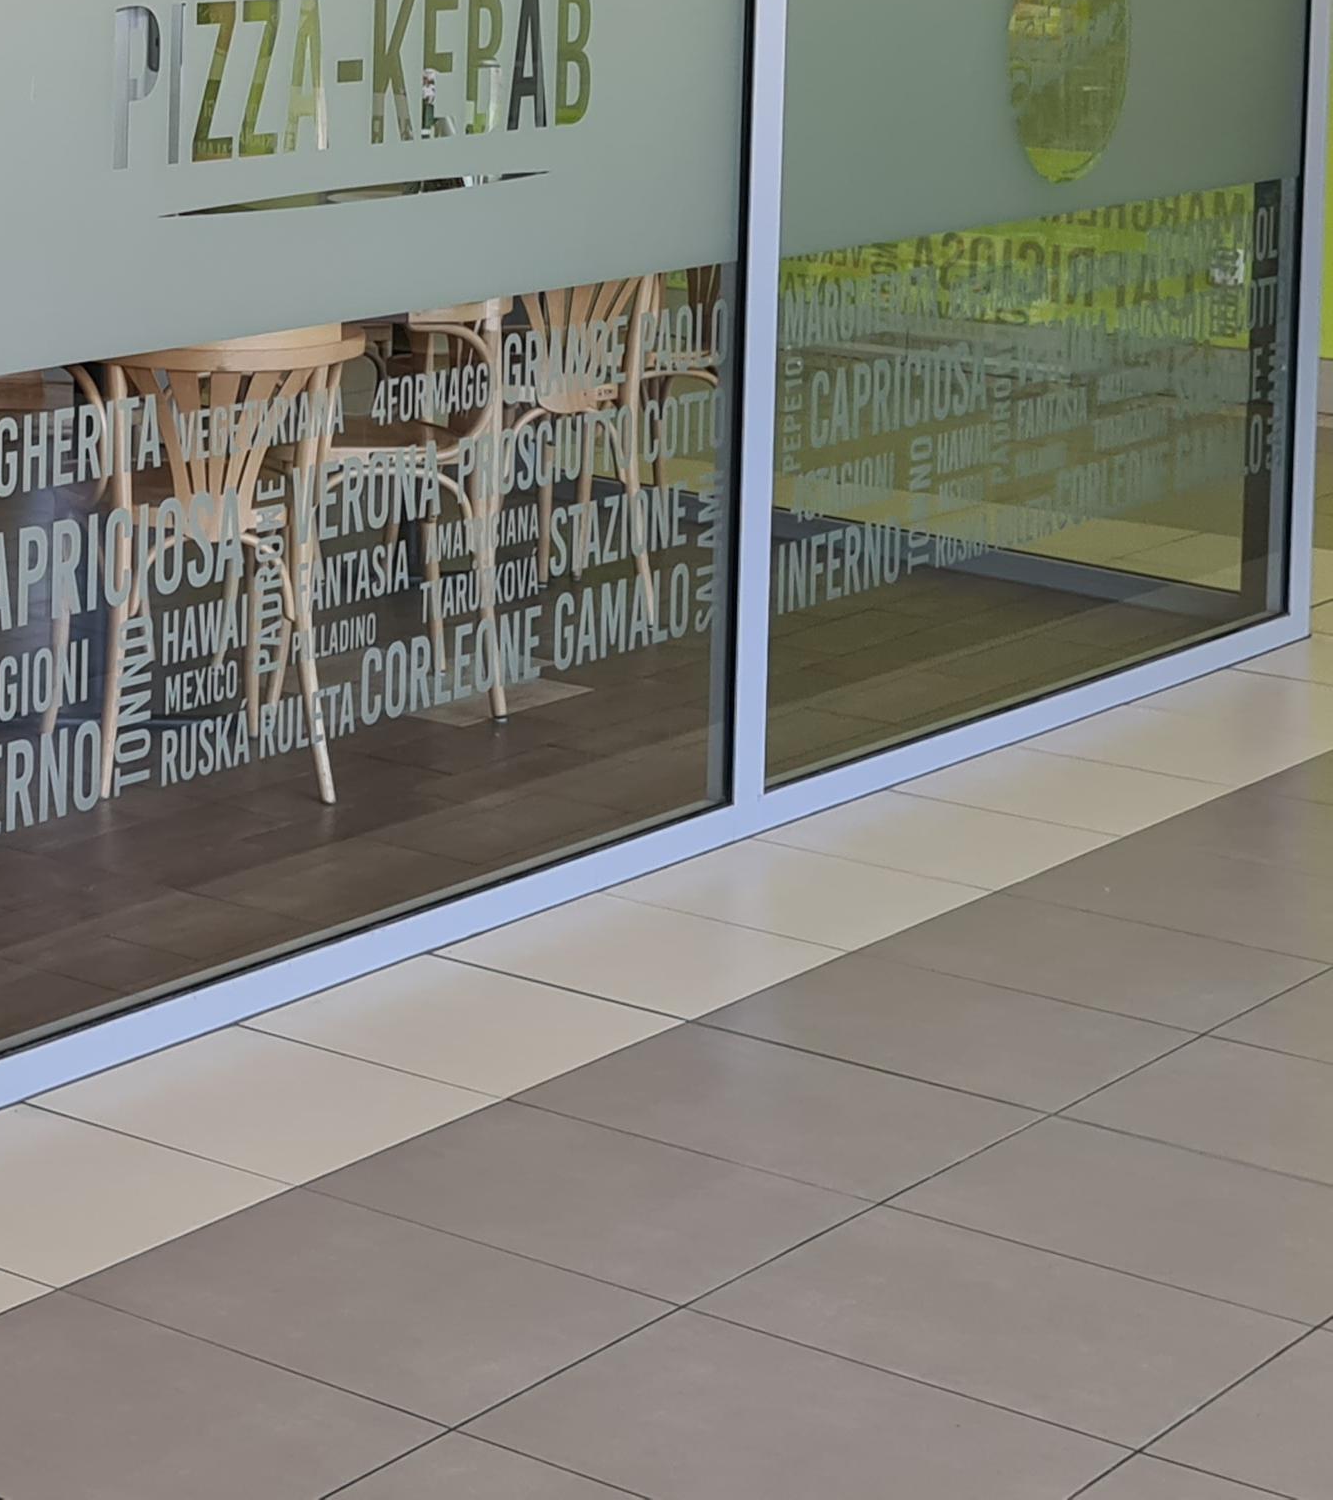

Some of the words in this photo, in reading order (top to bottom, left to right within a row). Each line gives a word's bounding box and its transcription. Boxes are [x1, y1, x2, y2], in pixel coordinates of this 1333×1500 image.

[371, 362, 490, 427] 4FORMAGG
[503, 315, 628, 406] GRANDE
[640, 299, 728, 375] PAOLO
[293, 440, 442, 547] VERONA
[457, 405, 633, 505] PROSCIUTTO
[643, 387, 726, 465] COTTO
[161, 594, 249, 667] HAWAI
[295, 539, 410, 613] FANTASIA
[425, 503, 540, 566] AMATCIANA
[549, 481, 687, 579] STAZIONE
[164, 660, 239, 716] MEXICO
[420, 556, 540, 624] TVARŮKOVÁ
[778, 514, 902, 615] INFERNO
[160, 698, 251, 787] RUSKÁ
[259, 680, 356, 759] RULETA
[360, 605, 542, 726] CORLEONE
[553, 563, 690, 671] GAMALO
